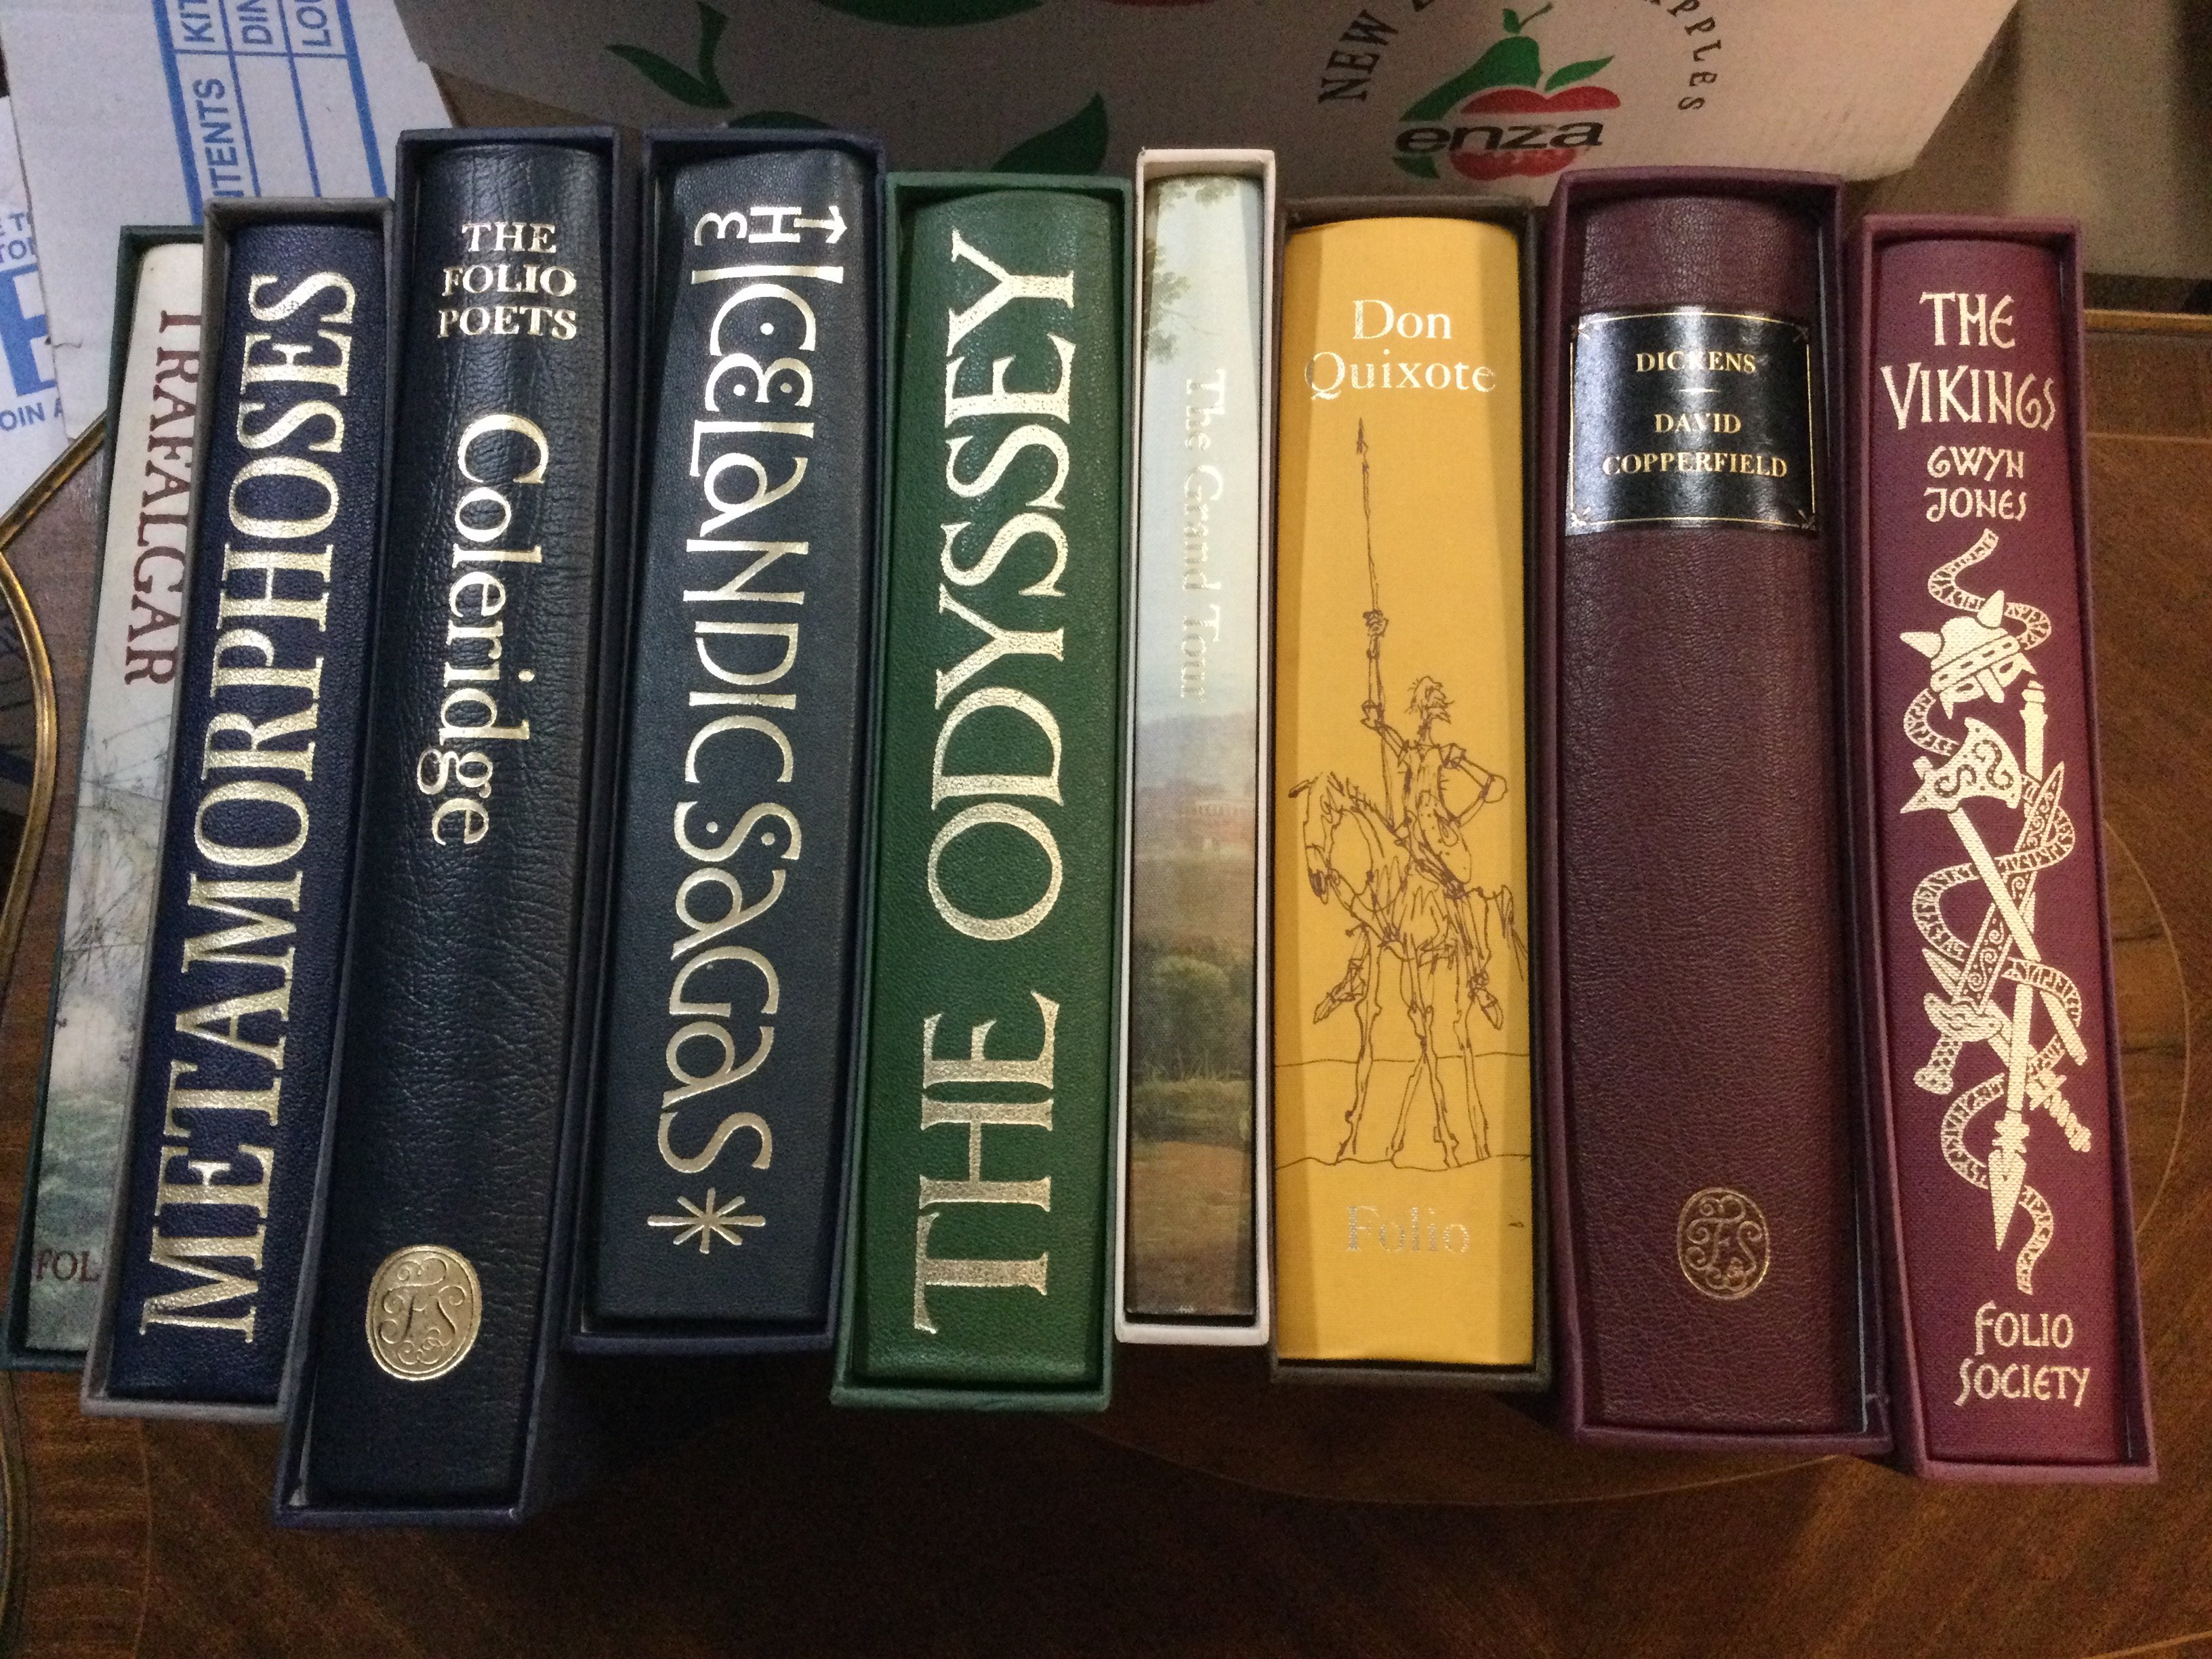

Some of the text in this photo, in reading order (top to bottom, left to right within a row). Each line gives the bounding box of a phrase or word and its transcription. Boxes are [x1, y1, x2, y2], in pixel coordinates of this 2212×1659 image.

[1317, 9, 1398, 104] NEW
[1395, 122, 1603, 154] enza
[462, 221, 557, 253] THE
[442, 263, 577, 297] FOLIO
[437, 305, 577, 340] POETS
[1353, 298, 1452, 340] Don
[1919, 291, 2015, 349] THE
[1304, 348, 1496, 401] Quixote
[1636, 351, 1757, 374] DICKENS
[1880, 362, 2056, 431] VIKINGS
[1654, 412, 1742, 434] DAVID
[1602, 451, 1788, 478] COPPERFIELD
[1927, 445, 2025, 482] GWYN
[1923, 487, 2028, 523] JONES
[1180, 368, 1225, 703] The Grand Tour
[417, 413, 549, 846] Coleridge
[914, 228, 1076, 1334] THE ODYSSEY
[139, 271, 356, 1343] METAMORPHOSES
[1346, 1205, 1470, 1252] Folio
[1975, 1300, 2074, 1356] FOLIO
[1953, 1357, 2091, 1408] SOCIETY
